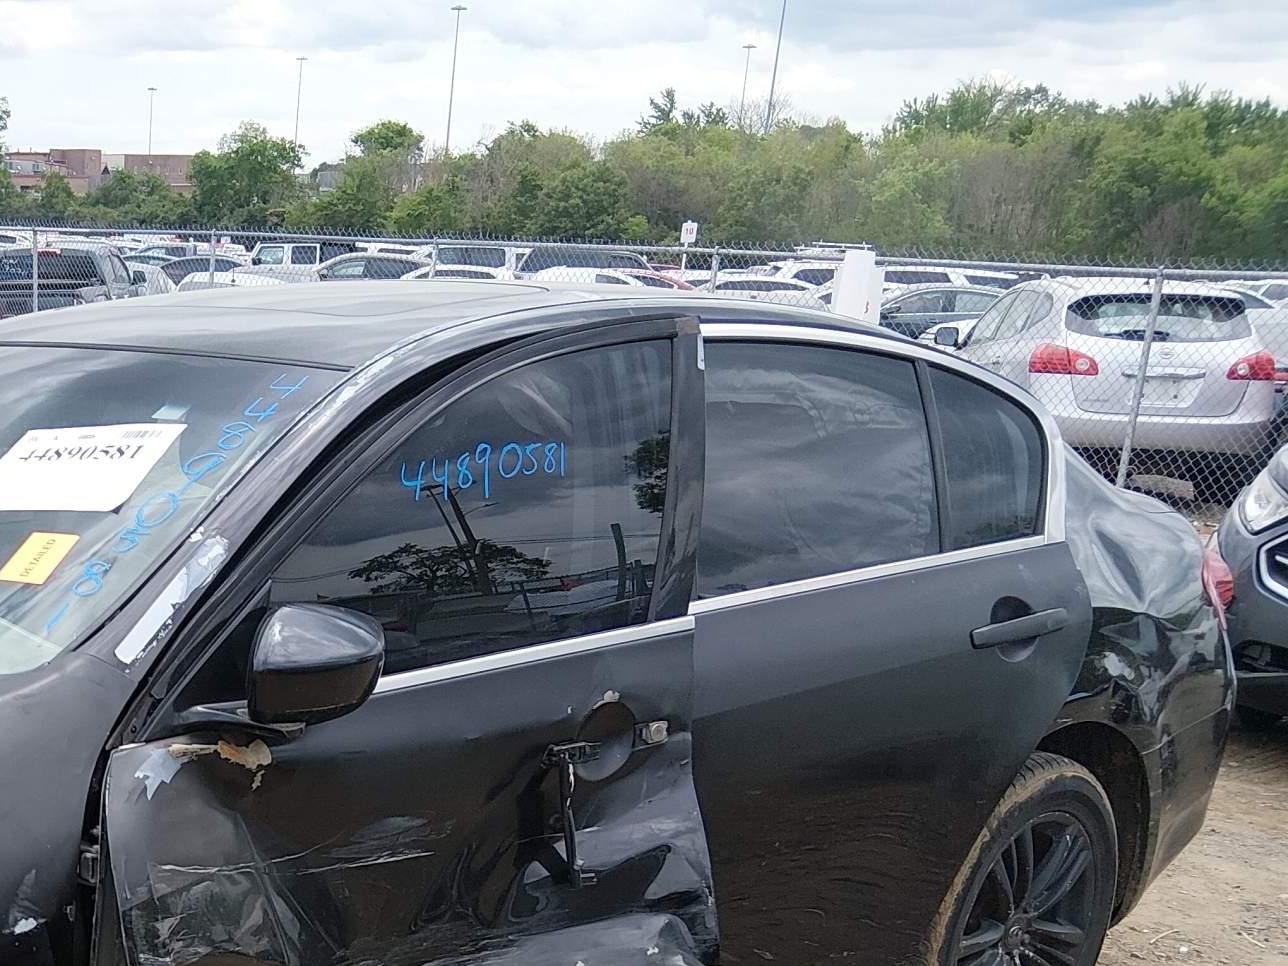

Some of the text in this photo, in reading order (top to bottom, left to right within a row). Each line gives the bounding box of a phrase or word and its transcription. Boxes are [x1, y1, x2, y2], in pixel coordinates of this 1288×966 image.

[17, 443, 145, 462] 44890581
[400, 441, 567, 502] 44890581
[19, 538, 57, 578] DETAILED
